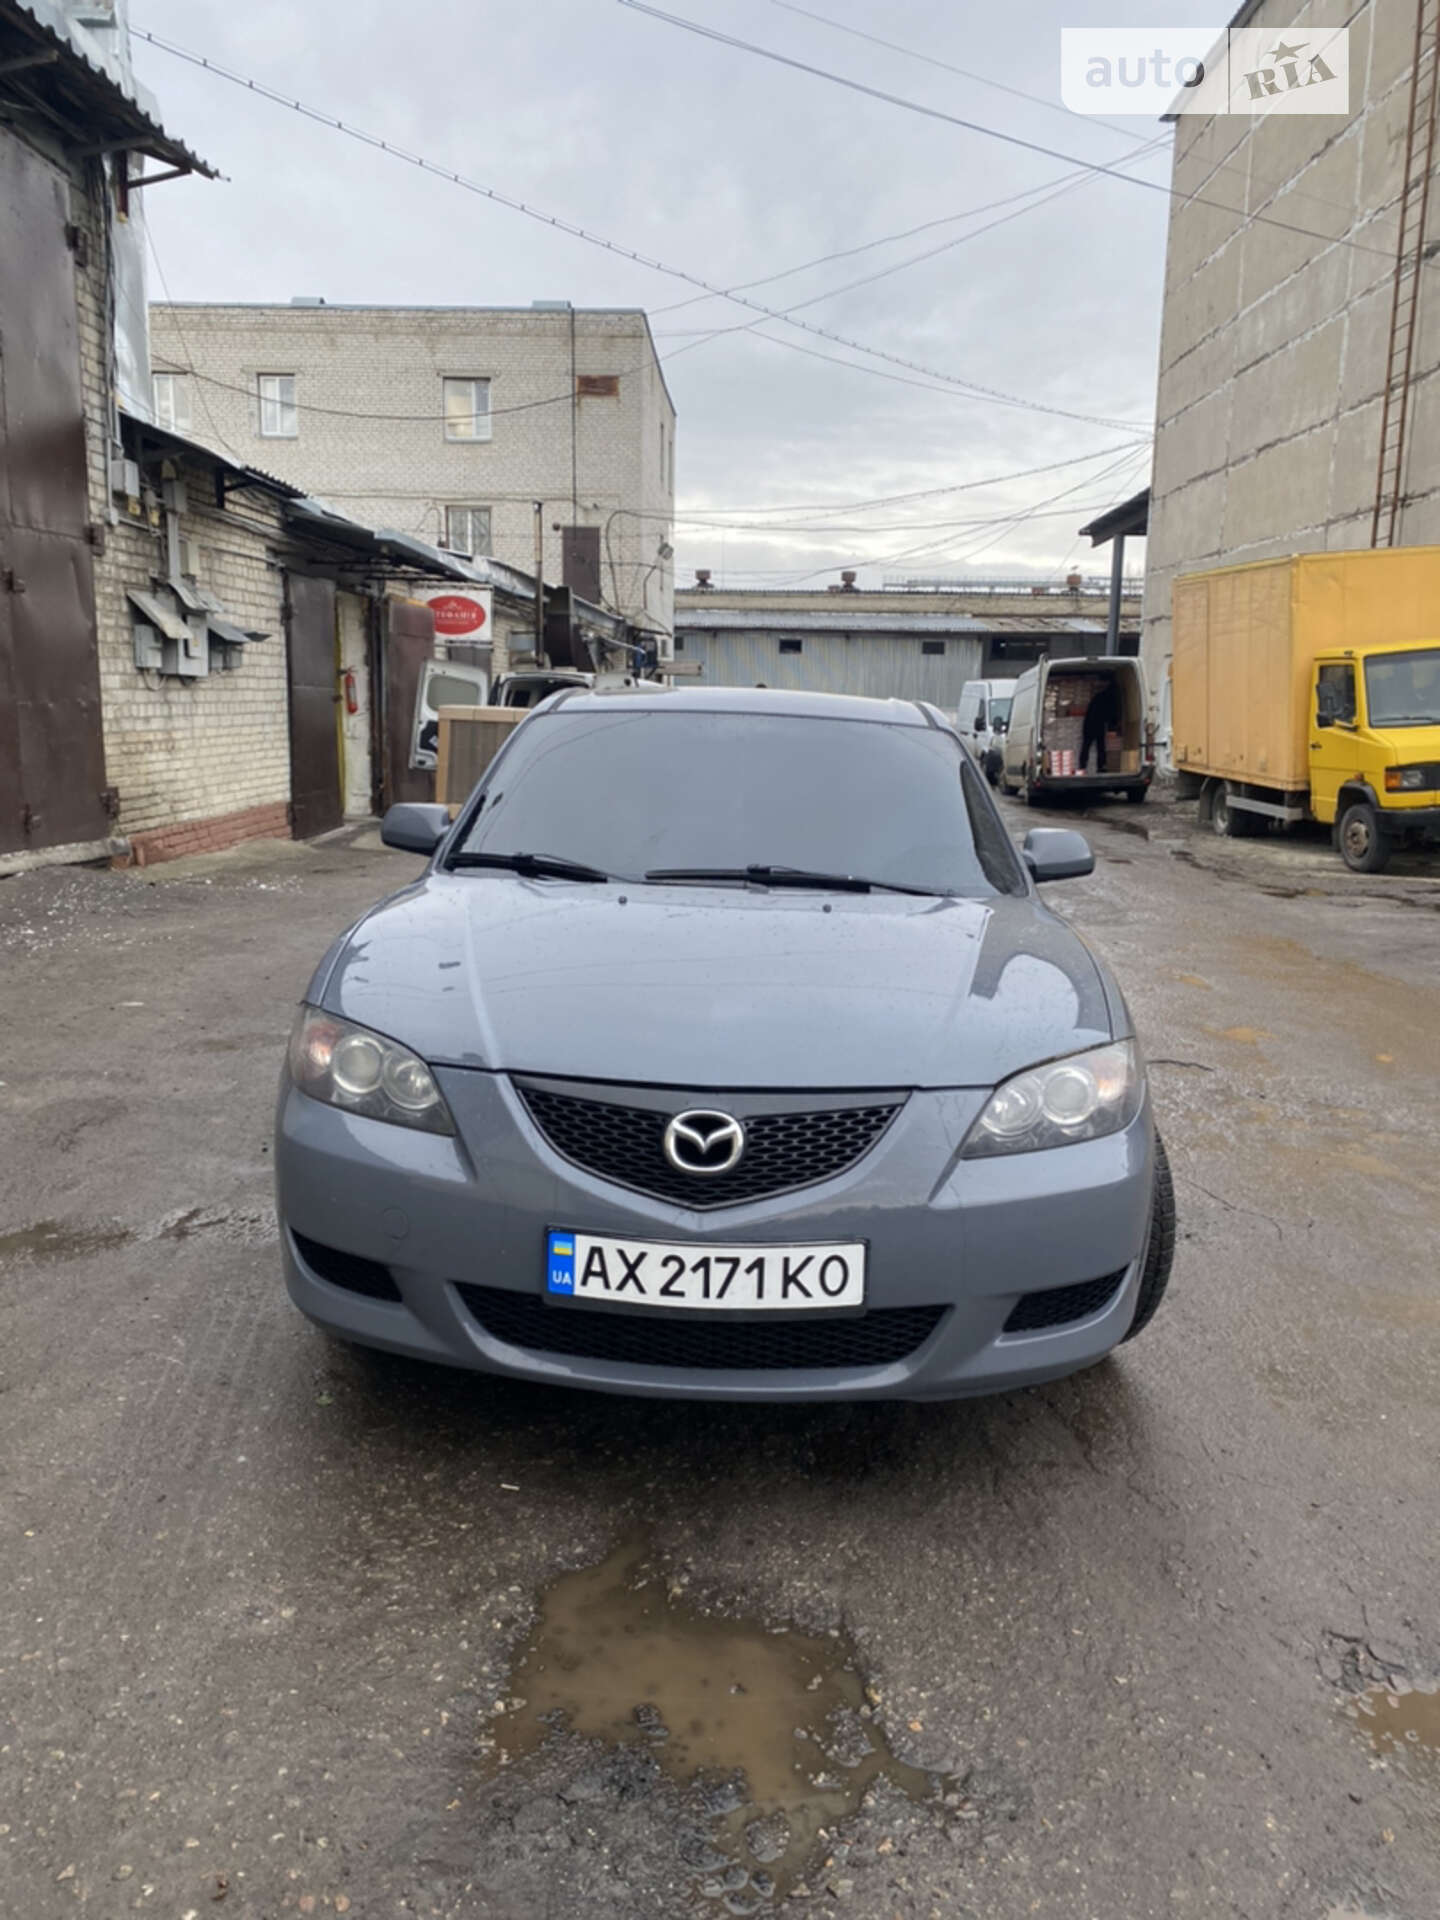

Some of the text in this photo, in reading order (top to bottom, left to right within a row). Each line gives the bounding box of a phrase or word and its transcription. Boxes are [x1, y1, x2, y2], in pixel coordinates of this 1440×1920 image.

[552, 1271, 572, 1285] UA
[580, 1246, 850, 1300] AX 2171 KO
